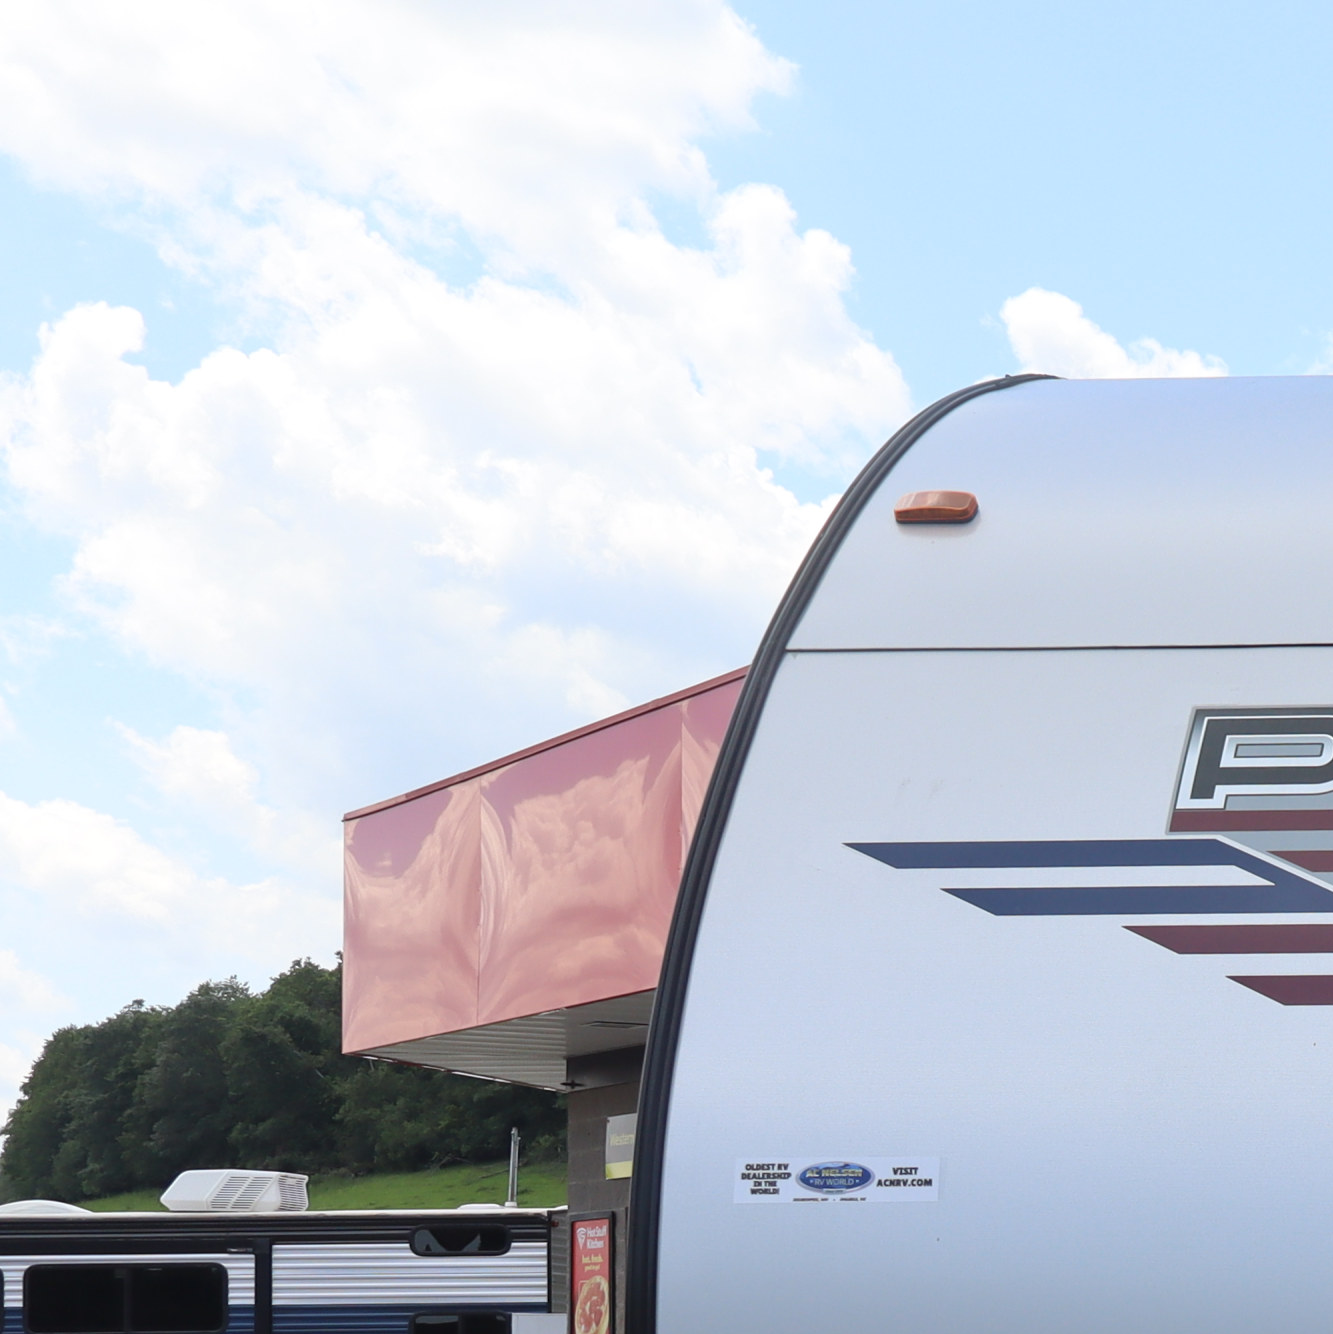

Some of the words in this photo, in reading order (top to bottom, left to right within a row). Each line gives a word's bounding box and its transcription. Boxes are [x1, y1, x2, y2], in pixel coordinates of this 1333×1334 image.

[745, 1163, 775, 1171] OLDEST
[777, 1163, 789, 1171] RV
[892, 1167, 919, 1175] VISIT
[741, 1172, 792, 1180] DEALERSHIP
[825, 1178, 855, 1186] WORLD
[876, 1178, 933, 1187] ACNRV.COM
